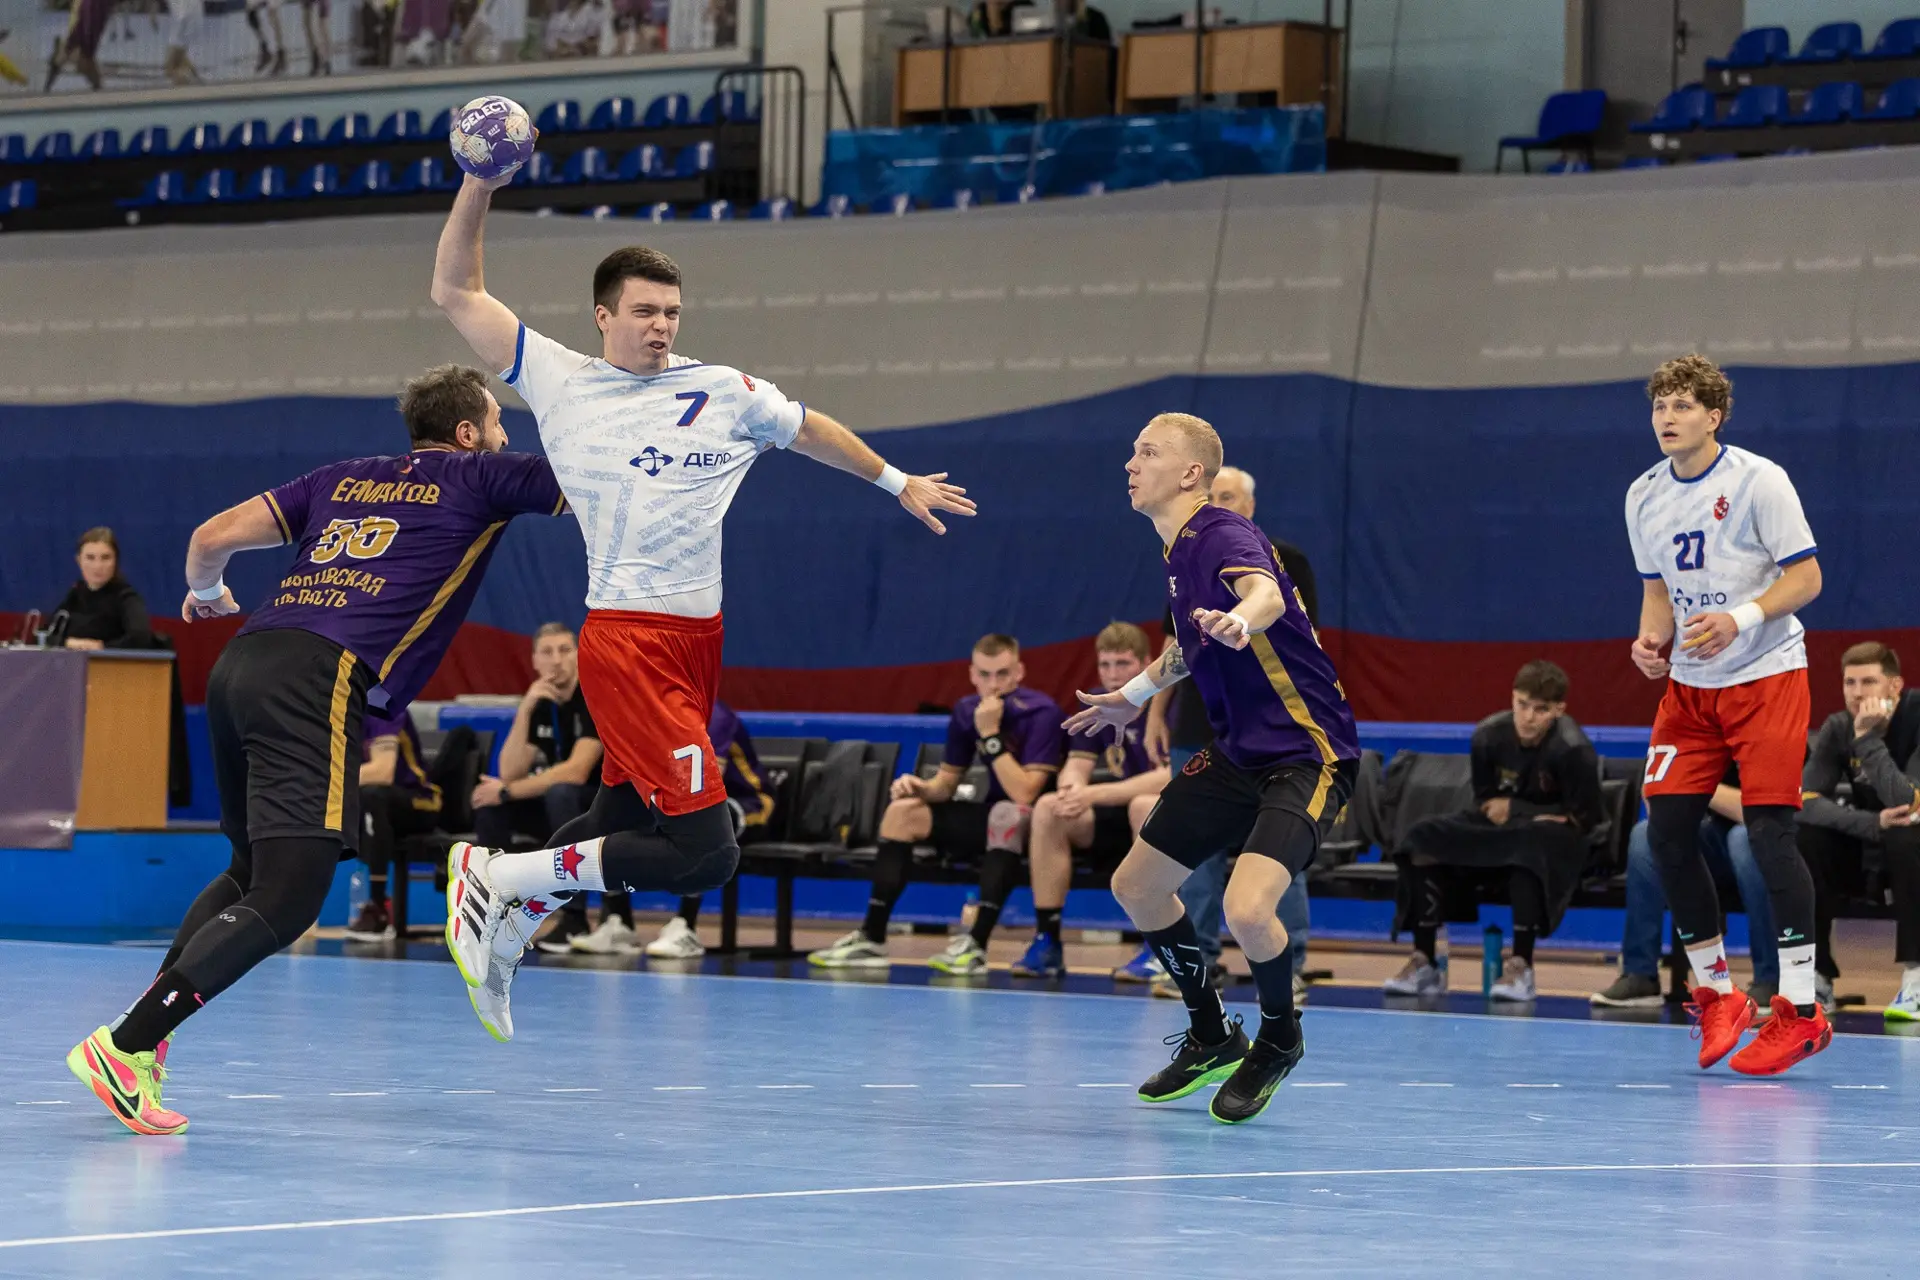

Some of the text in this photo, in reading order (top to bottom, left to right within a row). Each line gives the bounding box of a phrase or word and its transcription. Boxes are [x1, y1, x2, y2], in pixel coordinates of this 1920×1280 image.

[460, 101, 509, 133] SELECT
[675, 390, 709, 426] 7
[683, 452, 732, 468] ДЕЛО
[330, 476, 441, 504] ЕРМАКОВ
[1673, 530, 1706, 571] 27
[1700, 591, 1727, 607] ДО
[672, 743, 705, 795] 7
[1643, 744, 1678, 785] 27
[1160, 945, 1184, 976] 2XU
